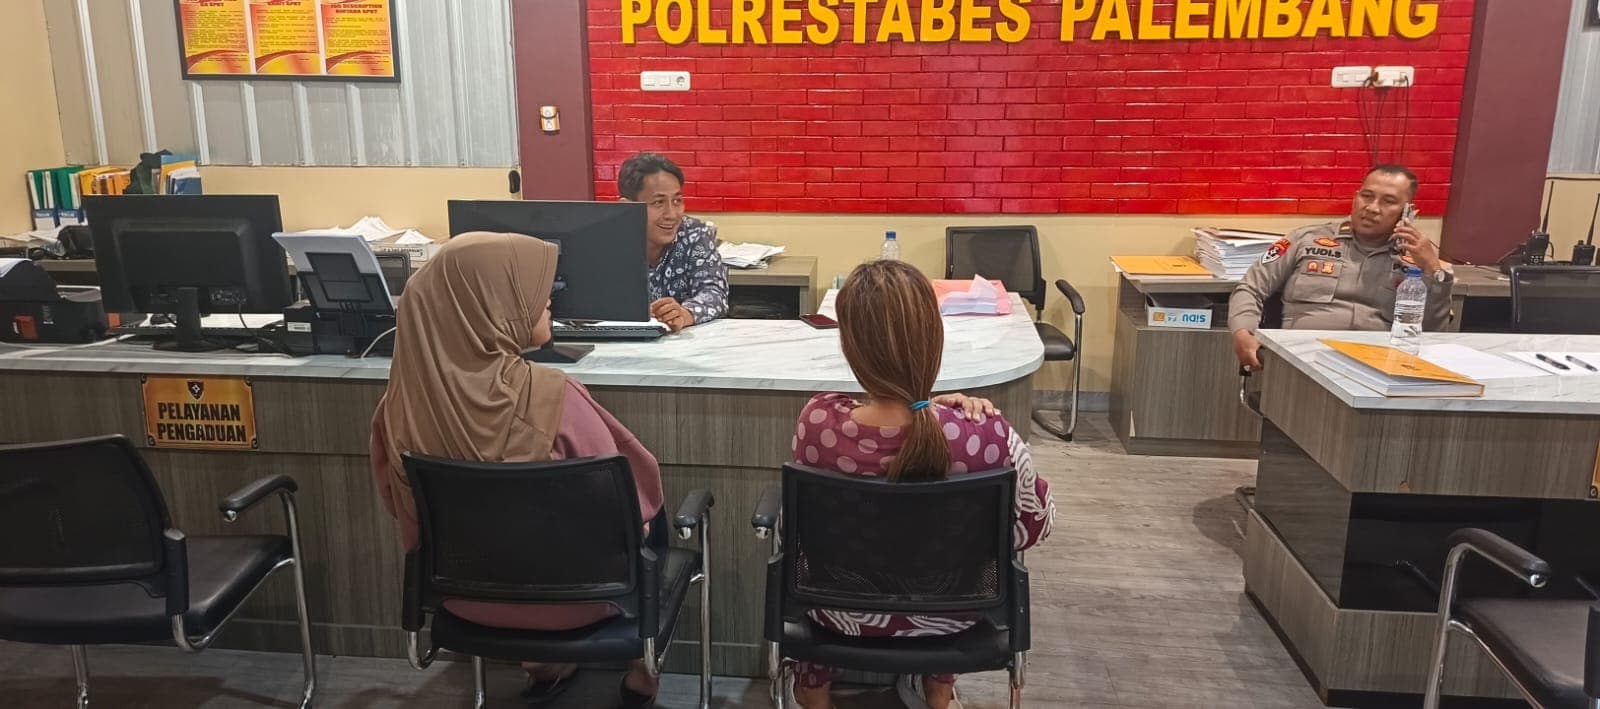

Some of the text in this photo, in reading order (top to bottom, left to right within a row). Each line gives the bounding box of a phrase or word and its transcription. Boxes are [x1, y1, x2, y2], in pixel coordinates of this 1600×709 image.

[621, 0, 1439, 44] POLRESTABES PALEMBANG
[157, 402, 241, 421] PELAYANAN
[156, 422, 247, 442] PENGADUAN
